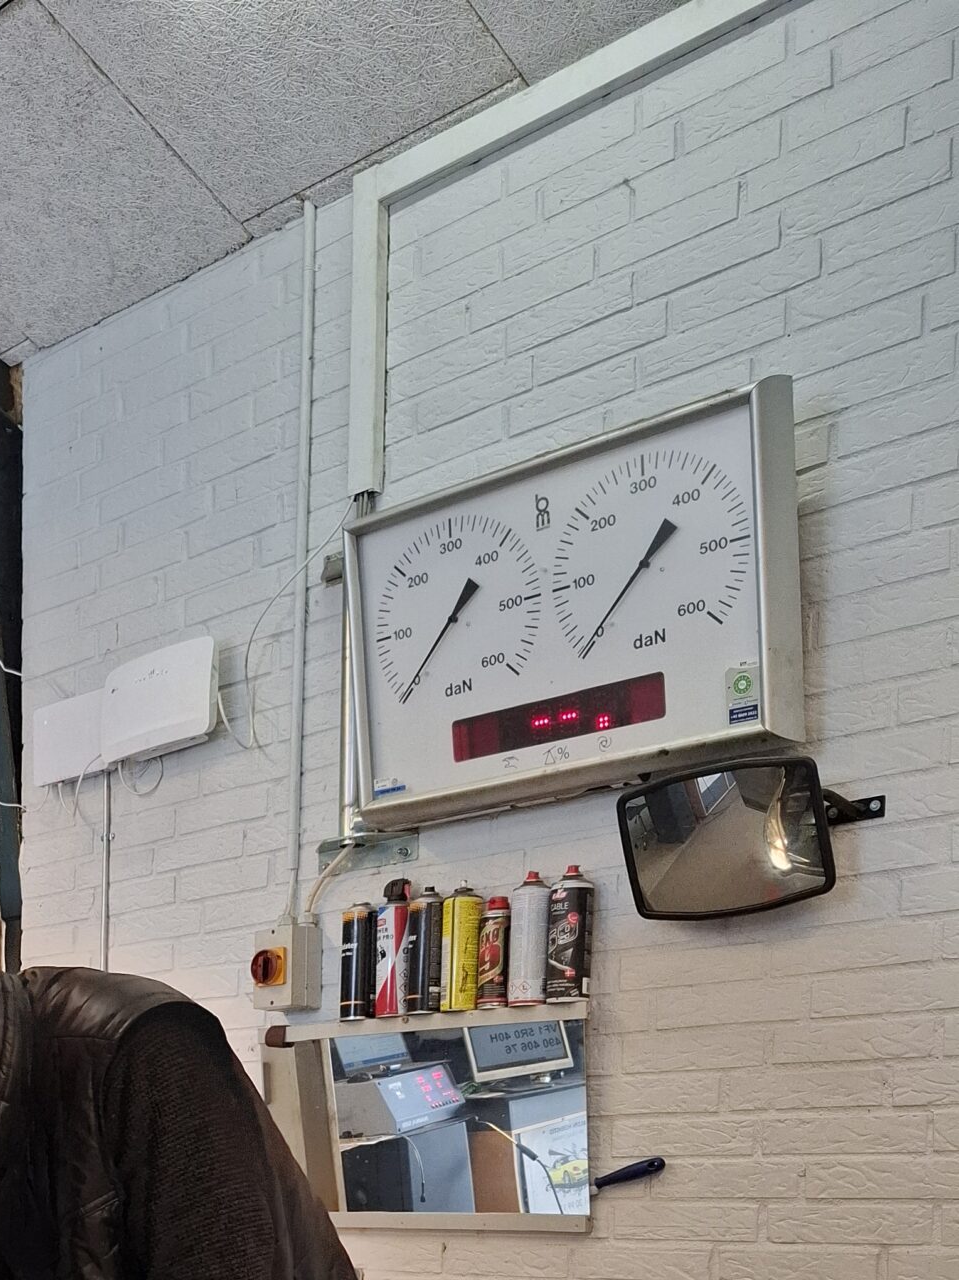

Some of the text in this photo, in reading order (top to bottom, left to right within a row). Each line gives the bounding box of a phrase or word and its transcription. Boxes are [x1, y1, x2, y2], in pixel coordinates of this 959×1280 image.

[629, 475, 657, 494] 300
[672, 488, 701, 506] 400
[590, 514, 616, 532] 200
[439, 538, 462, 554] 300
[699, 536, 728, 555] 500
[475, 550, 499, 566] 400
[407, 572, 429, 588] 200
[573, 574, 595, 589] 100
[499, 595, 523, 611] 500
[677, 599, 706, 617] 600
[394, 627, 412, 640] 100
[596, 626, 604, 638] 0
[633, 628, 666, 650] daN
[481, 652, 505, 668] 600
[413, 674, 421, 686] 0
[445, 678, 473, 697] daN
[550, 901, 569, 912] CABLE
